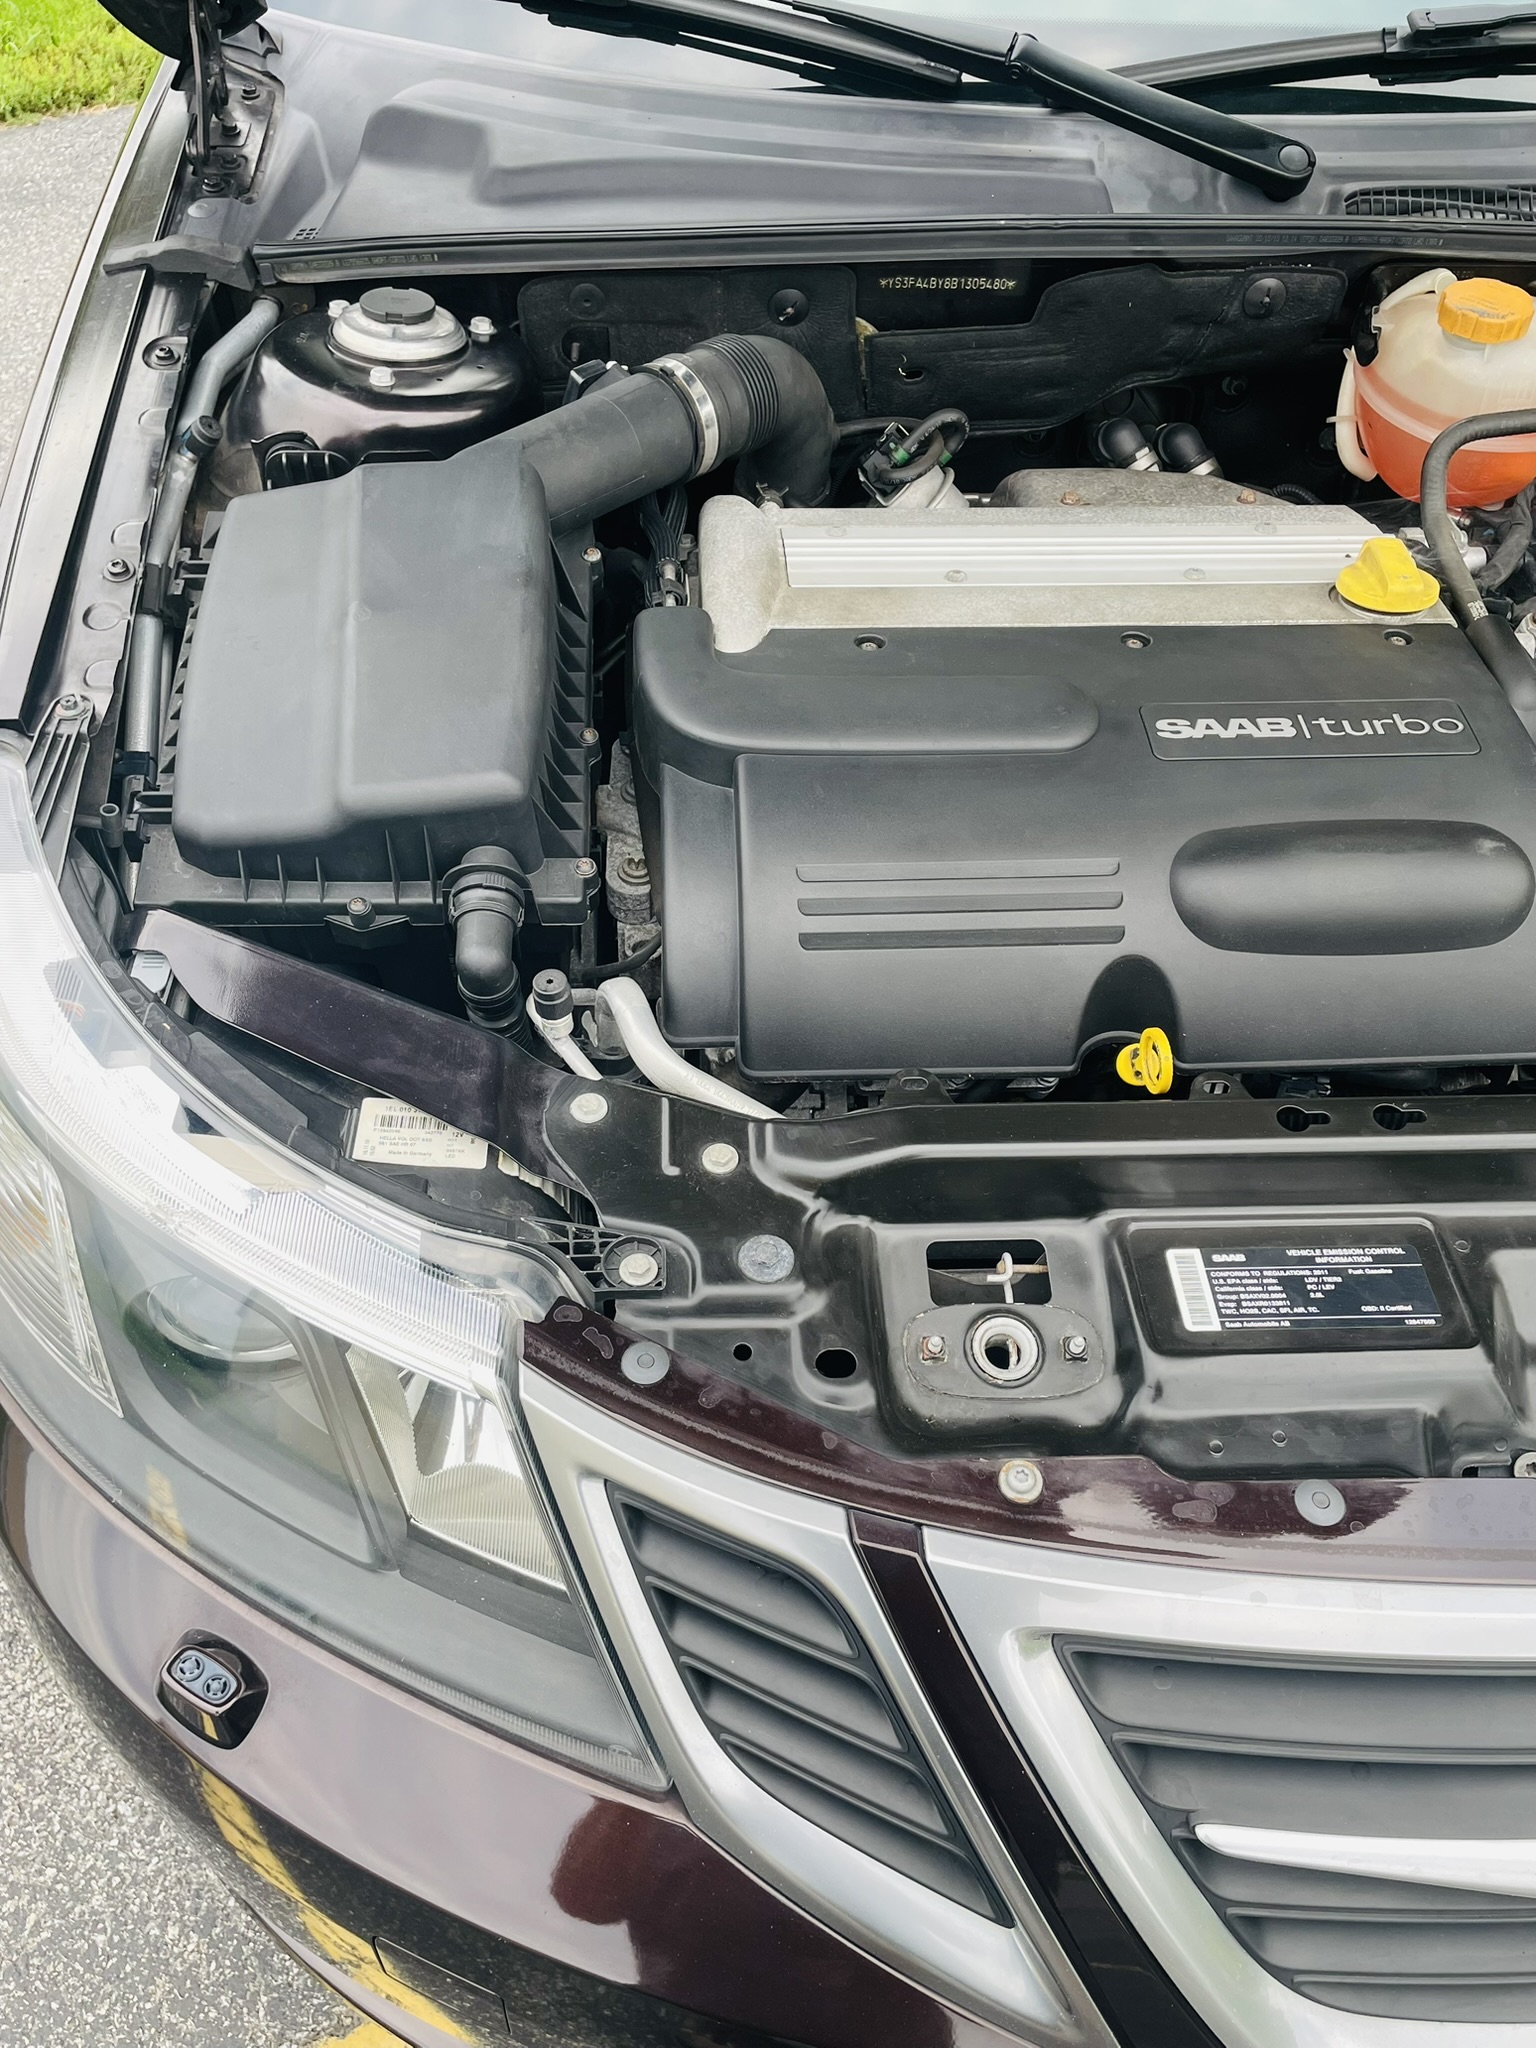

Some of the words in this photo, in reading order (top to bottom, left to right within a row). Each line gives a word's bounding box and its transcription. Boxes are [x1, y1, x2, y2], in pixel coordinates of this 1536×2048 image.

[1155, 717, 1298, 739] SAAB
[1311, 713, 1465, 736] turbo
[1286, 1249, 1322, 1257] VEHICLE
[1323, 1248, 1364, 1256] EMISSION
[1364, 1247, 1406, 1255] CONTROL
[1211, 1253, 1247, 1263] SAAB
[1315, 1256, 1374, 1264] INFORMATION
[1364, 1267, 1394, 1275] Gasoline
[1226, 1277, 1242, 1285] EPA
[1261, 1307, 1280, 1315] CAC,
[1243, 1320, 1280, 1328] Automobile
